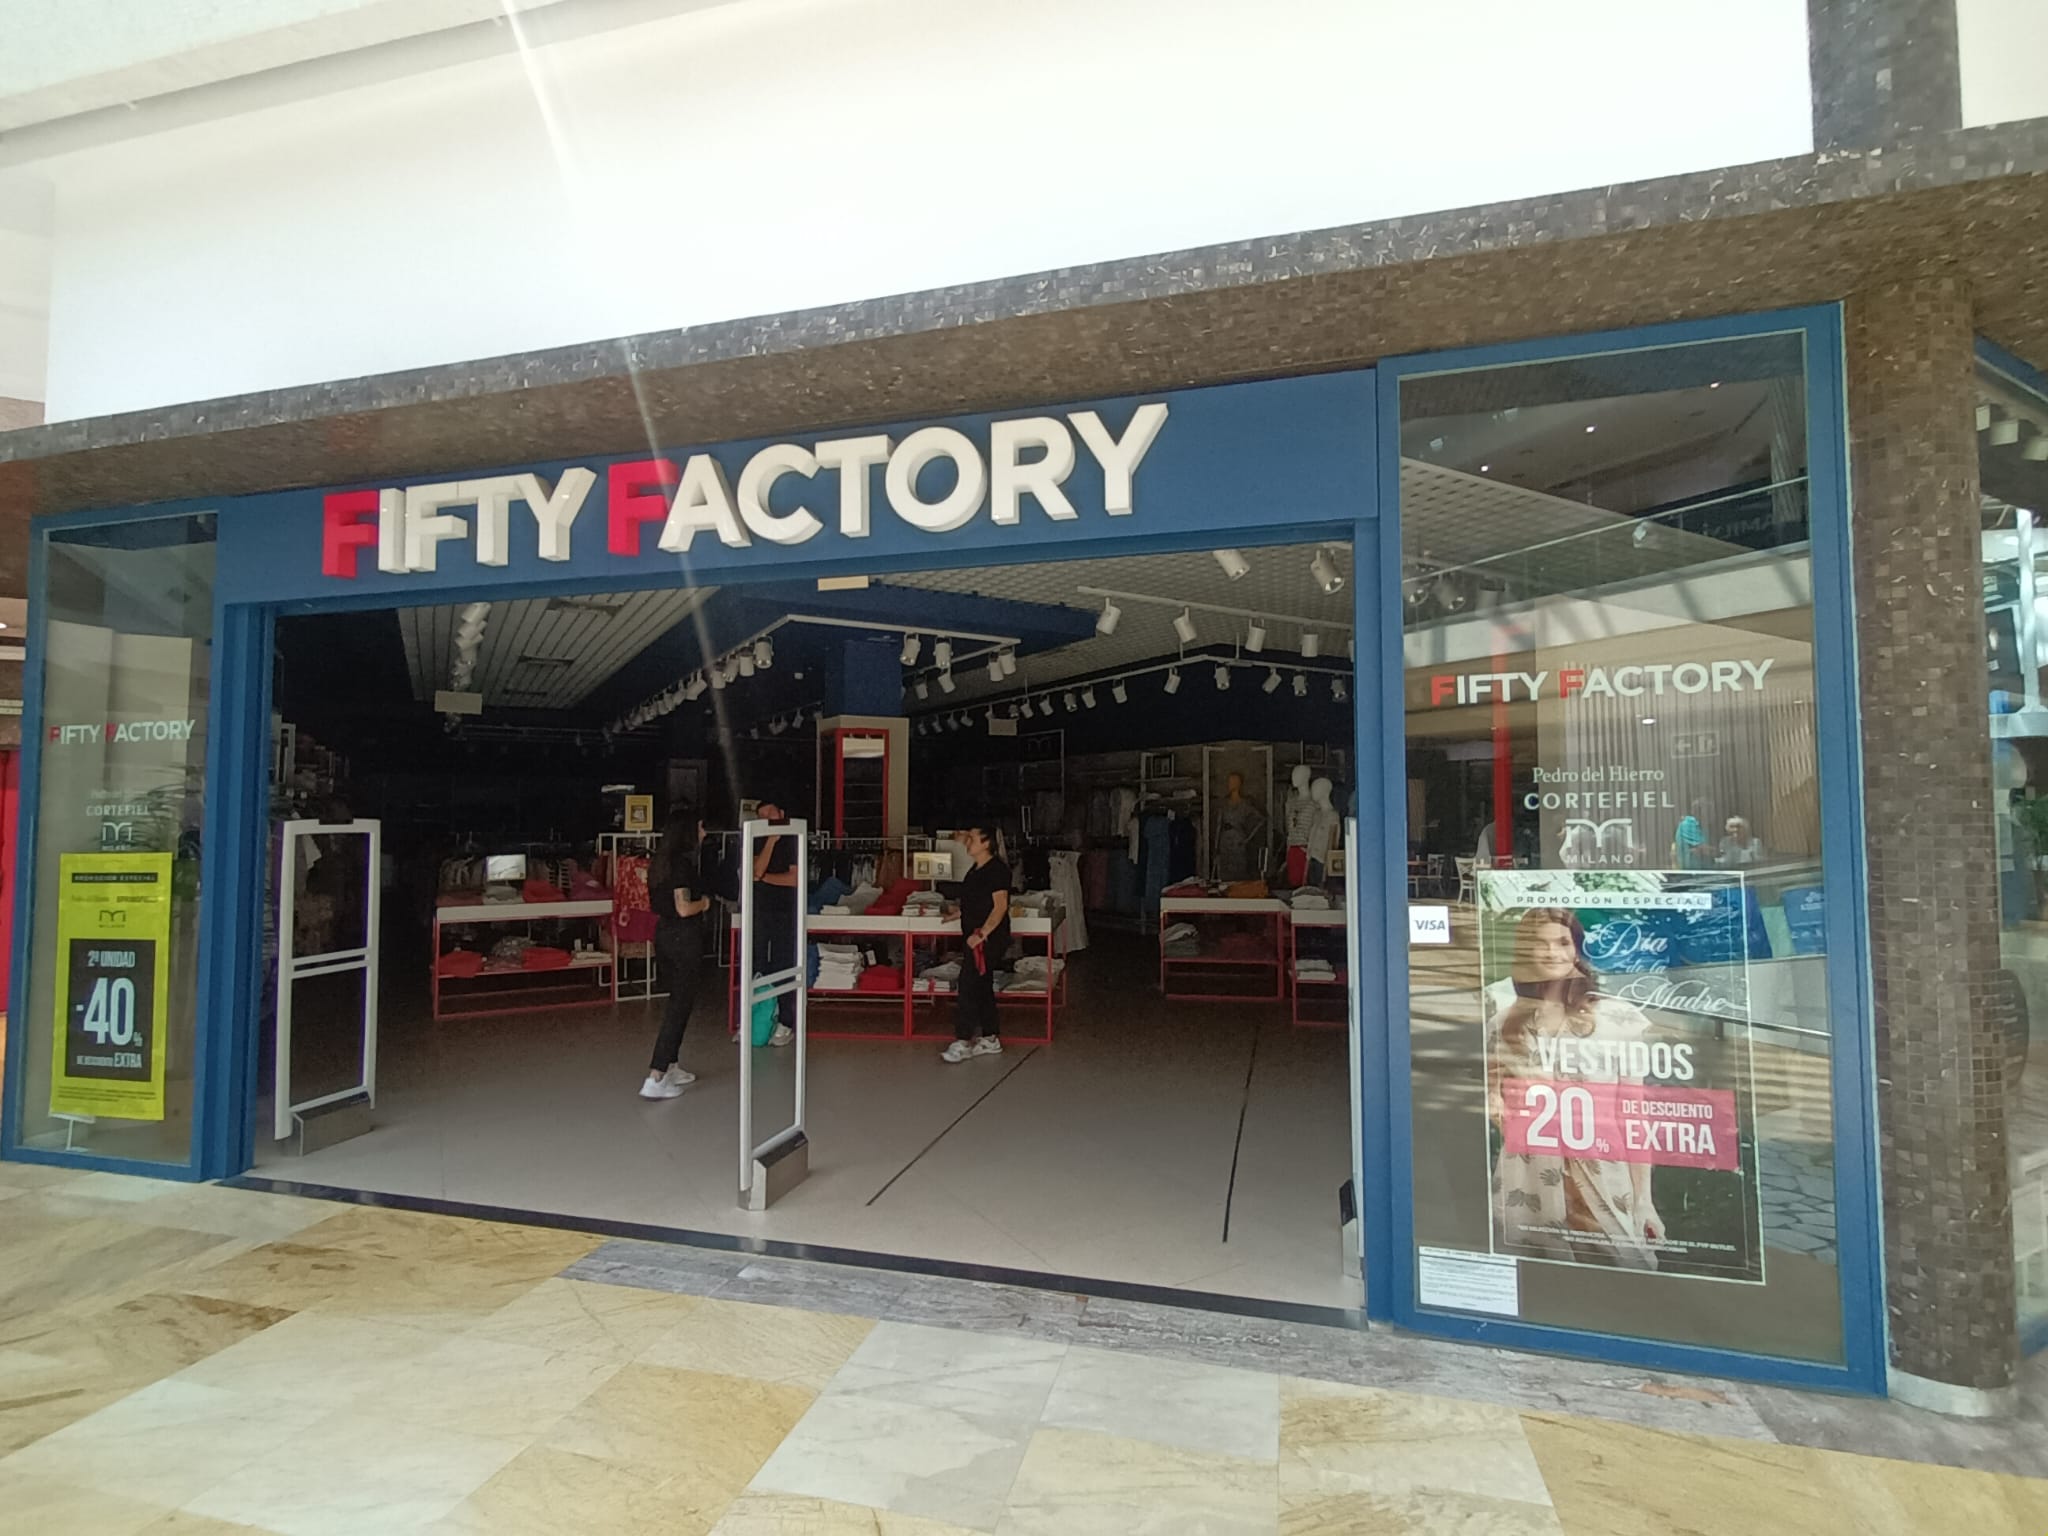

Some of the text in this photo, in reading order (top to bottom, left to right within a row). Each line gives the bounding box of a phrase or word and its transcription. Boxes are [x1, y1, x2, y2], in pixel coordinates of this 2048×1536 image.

[322, 403, 1169, 580] FIFTY FACTORY
[1430, 658, 1775, 706] FIFTY FACTORY
[49, 719, 195, 745] FIFTY FACTORY
[1533, 765, 1665, 784] Pedro del Hierro
[1524, 791, 1675, 811] CORTEFIEL
[1564, 852, 1634, 865] MILANO
[1622, 896, 1708, 907] ESPECIAL
[1415, 919, 1446, 931] VISA
[100, 951, 136, 967] UNIDAD
[1650, 957, 1669, 973] la
[1618, 975, 1747, 1011] Madre
[114, 1052, 142, 1068] EXTRA
[1538, 1036, 1695, 1081] VESTIDOS
[1622, 1099, 1713, 1119] DE DESCUENTO
[1625, 1118, 1716, 1155] EXTRA
